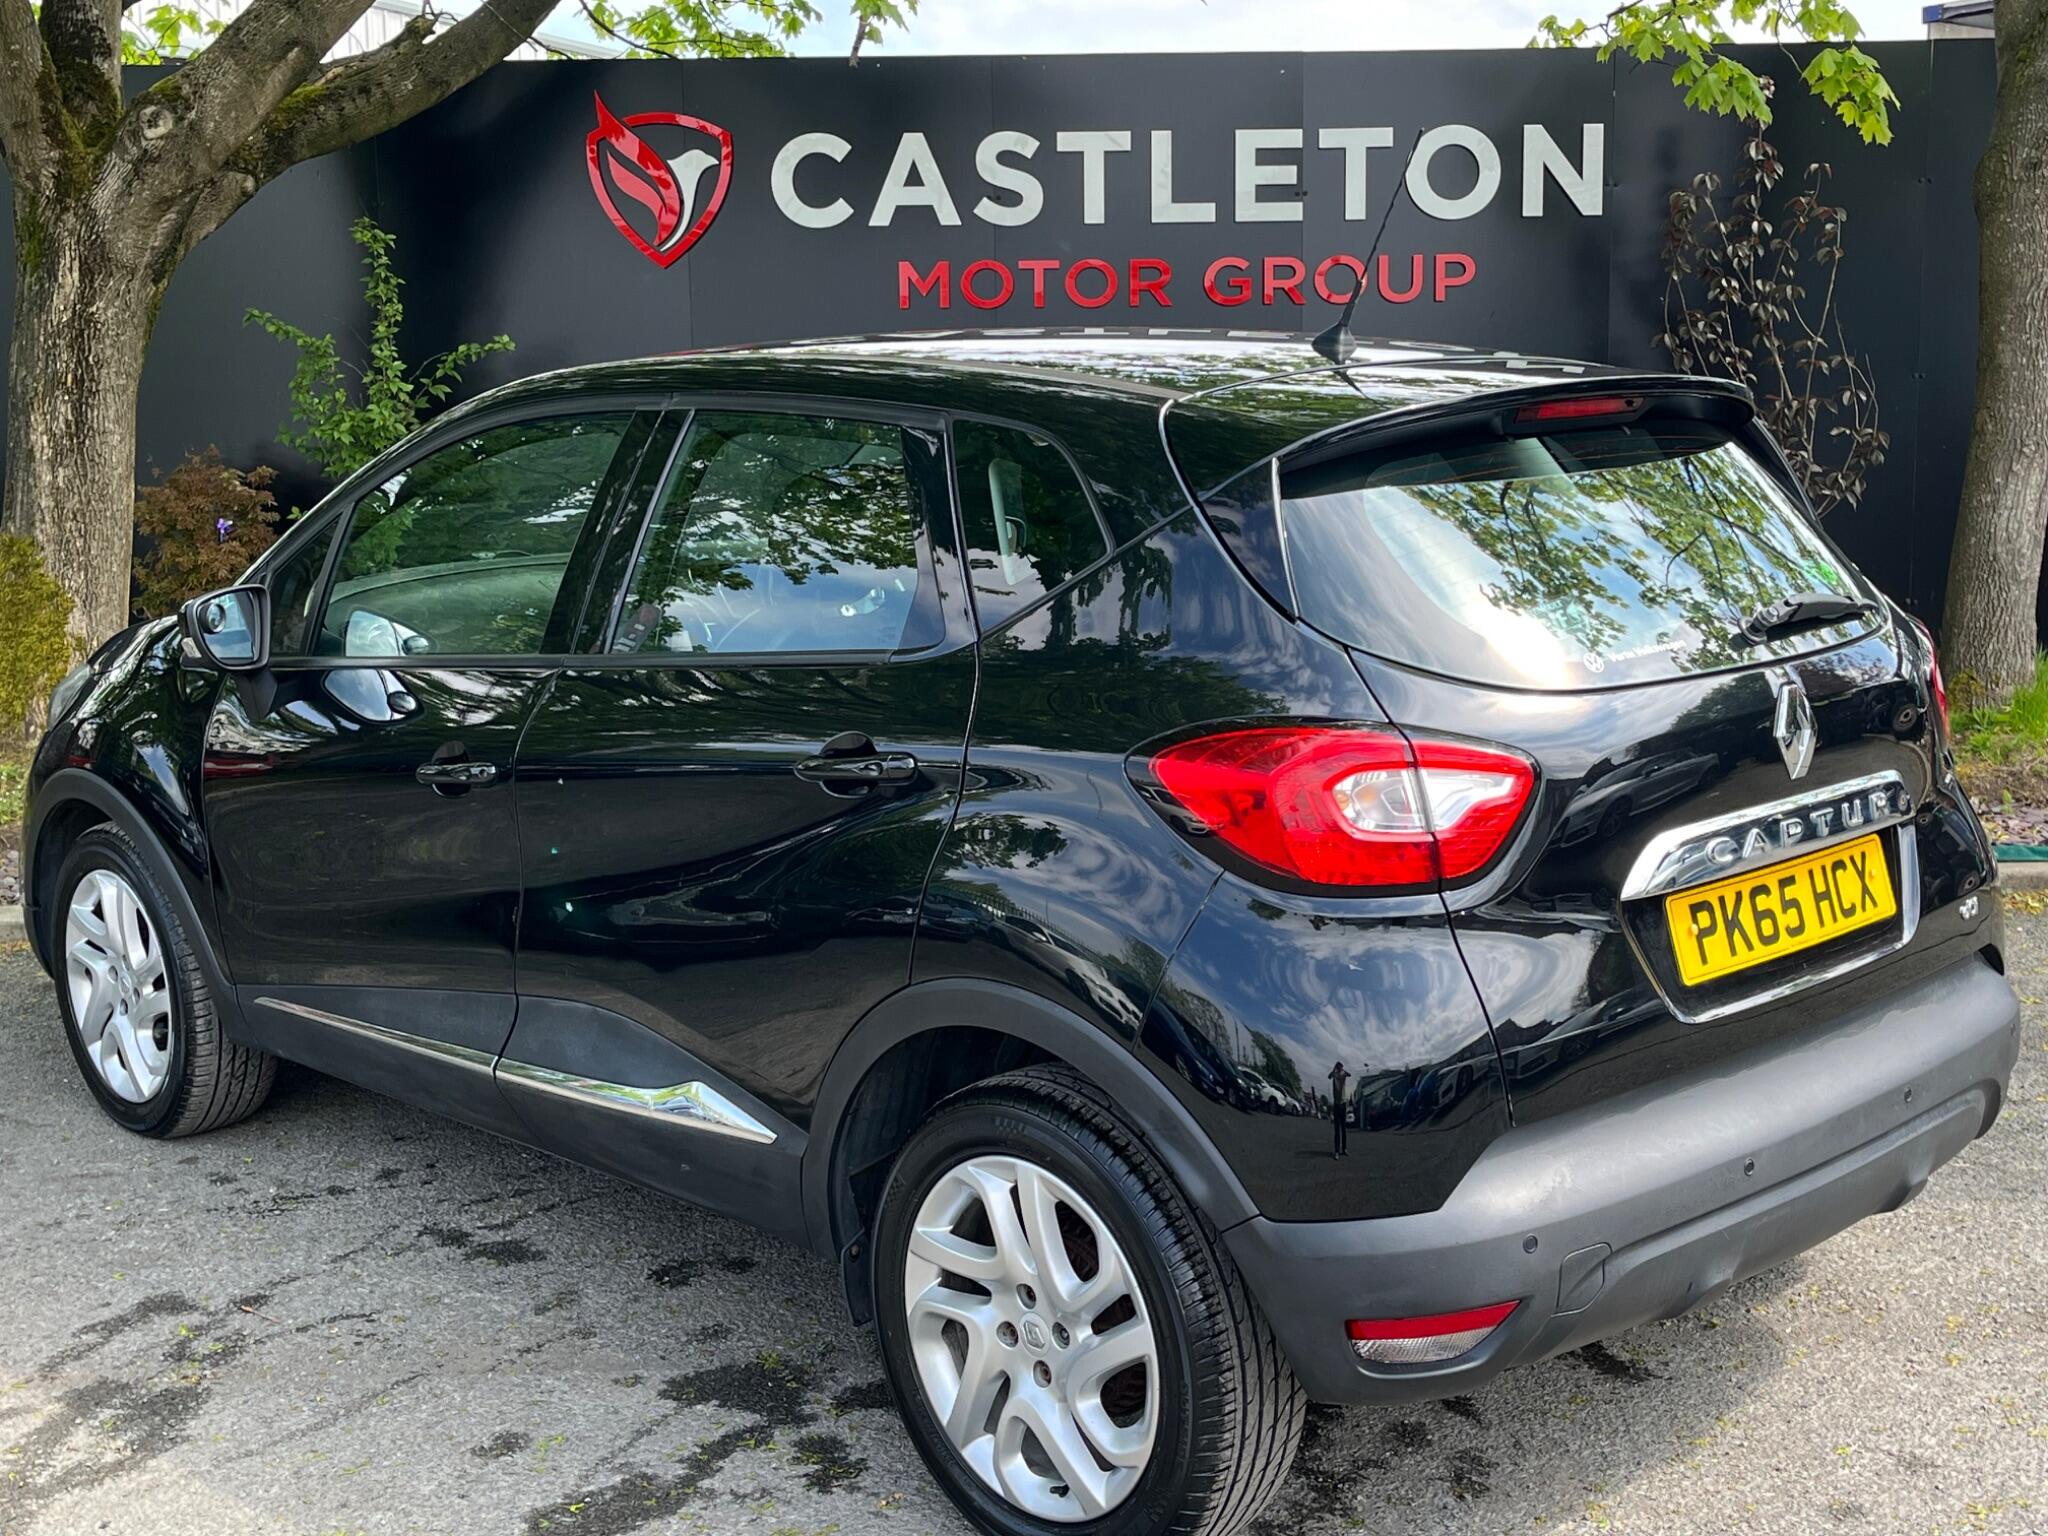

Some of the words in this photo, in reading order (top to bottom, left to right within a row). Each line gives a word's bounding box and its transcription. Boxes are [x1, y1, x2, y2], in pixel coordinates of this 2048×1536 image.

[770, 123, 1604, 228] CASTLETON
[897, 258, 1173, 309] MOTOR
[1203, 252, 1476, 306] GROUP
[1706, 791, 1891, 865] CAPTUR
[1689, 876, 1805, 966] PK65
[1812, 851, 1878, 928] HCX
